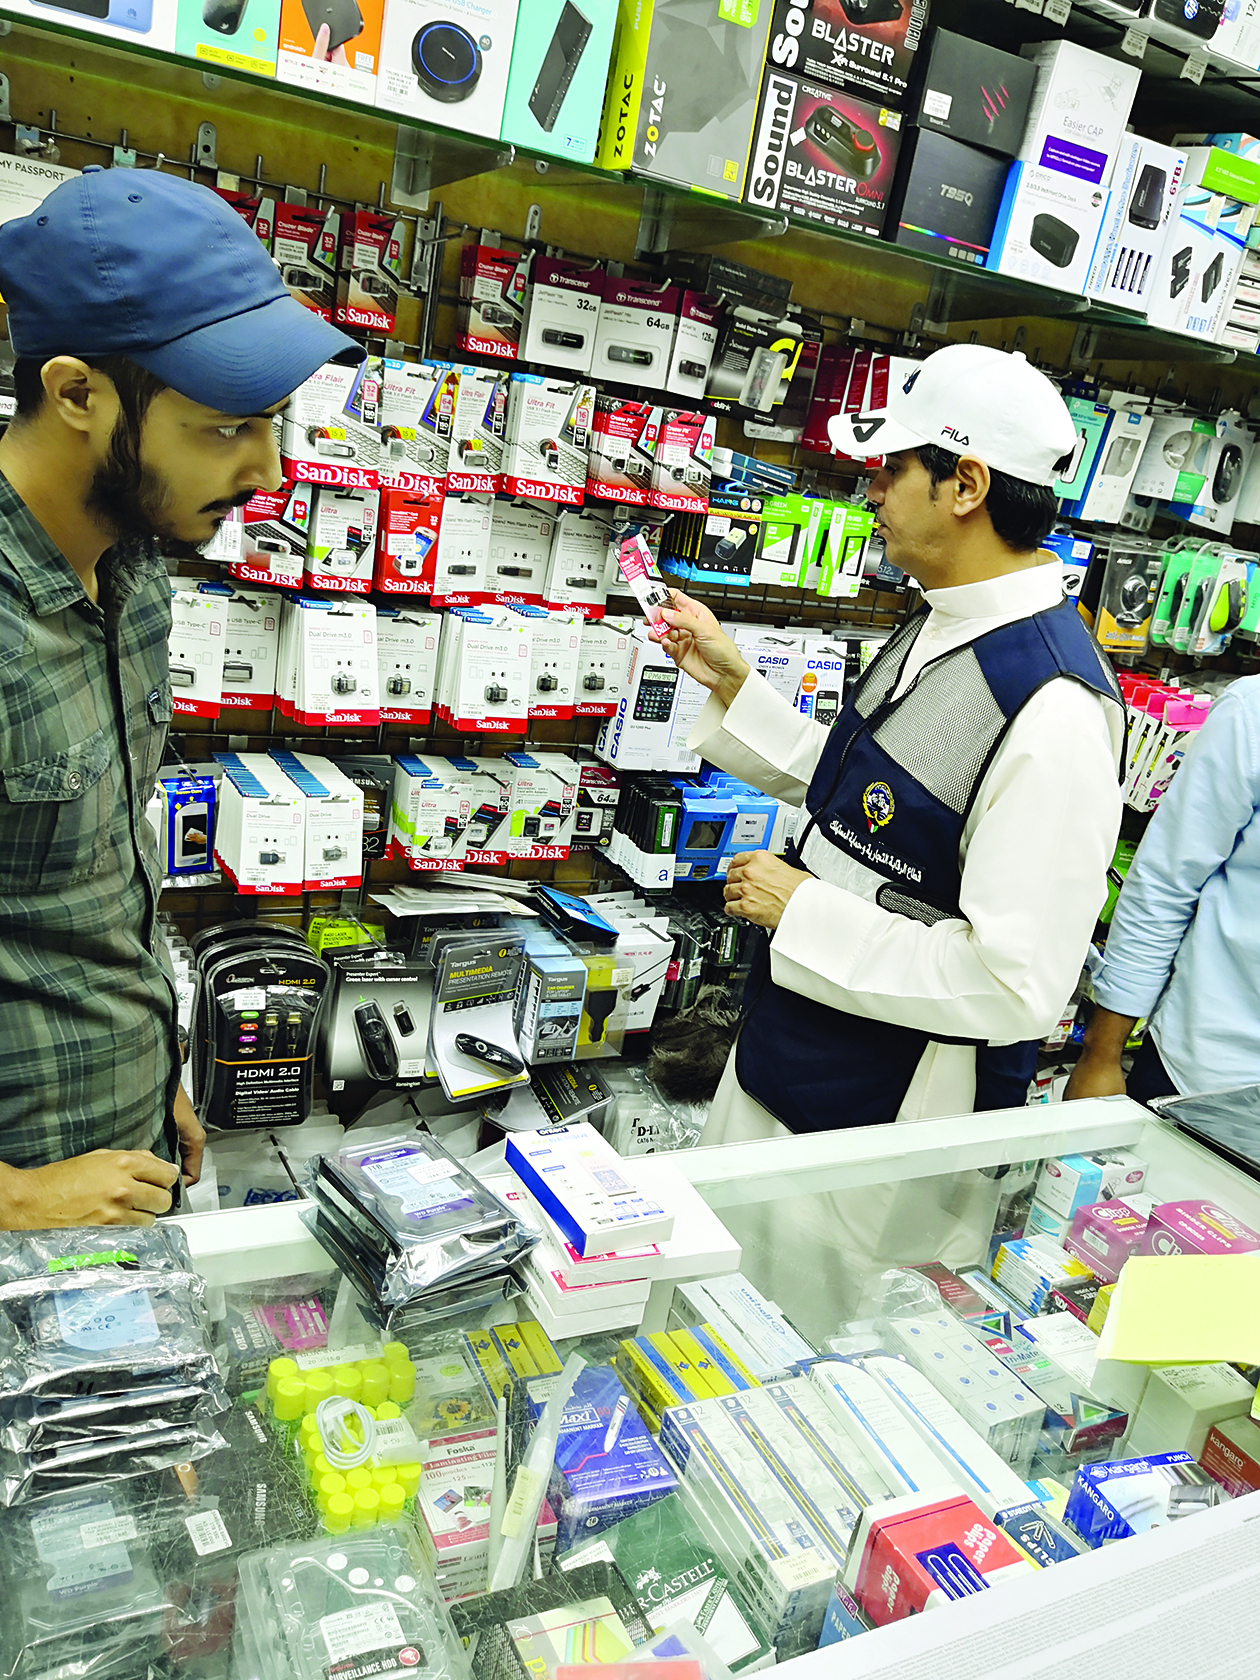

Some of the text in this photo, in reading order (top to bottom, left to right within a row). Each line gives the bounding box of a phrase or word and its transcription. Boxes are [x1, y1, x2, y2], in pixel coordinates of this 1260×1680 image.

[811, 18, 895, 66] BLASTER
[848, 59, 882, 79] Surround
[894, 75, 908, 88] Pro
[801, 85, 834, 102] CREATIVE
[613, 72, 634, 158] ZOTAC
[643, 75, 667, 158] ZOTAC
[1063, 116, 1104, 137] Easier CAP
[754, 80, 794, 202] Sound
[14, 161, 65, 181] PASSPORT
[784, 160, 857, 195] BLASTER
[278, 221, 315, 234] Cruzer Blade
[357, 228, 385, 241] Cruzer Blade
[559, 276, 590, 289] Transcend
[577, 298, 597, 312] 32GB
[626, 295, 662, 307] Transcend
[348, 310, 390, 329] SanDisk
[646, 317, 670, 330] 64GB
[468, 337, 516, 358] SanDisk
[325, 374, 344, 384] Flair
[384, 383, 416, 395] Ultra Fit
[442, 397, 452, 405] 64
[527, 399, 556, 409] Ultra Fit
[578, 411, 587, 419] 16
[941, 425, 970, 446] FILA
[296, 462, 373, 488] SanDisk
[448, 474, 496, 491] SanDisk
[516, 480, 580, 502] SanDisk
[598, 484, 646, 503] SanDisk
[295, 503, 305, 511] 64
[659, 494, 707, 511] SanDisk
[321, 506, 338, 514] Ultra
[240, 566, 298, 587] SanDisk
[313, 576, 368, 592] SanDisk
[384, 579, 433, 593] SanDisk
[444, 594, 470, 604] SanDisk
[495, 594, 526, 604] SanDisk
[563, 605, 591, 615] SanDisk
[758, 656, 789, 666] CASIO
[807, 660, 842, 670] CASIO
[379, 710, 412, 721] SanDisk
[529, 707, 558, 717] SanDisk
[576, 705, 607, 714] SanDisk
[325, 713, 361, 723] SanDisk
[476, 719, 510, 730] SanDisk
[609, 697, 628, 759] CASIO
[413, 859, 461, 870] SanDisk
[254, 884, 285, 893] SanDisk
[320, 879, 347, 888] SanDisk
[450, 960, 477, 968] Targus
[448, 969, 513, 985] PRESENTATION REMOTE
[449, 965, 493, 980] MULTIMEDIA
[237, 1066, 301, 1079] HDMI 2.0
[368, 1163, 383, 1171] 1TB
[425, 1205, 446, 1215] Purple
[1175, 1207, 1233, 1248] BINDER CLIPS
[1003, 1351, 1040, 1364] Tri-Mate
[244, 1410, 268, 1443] SAMSUNG
[446, 1445, 476, 1456] Foska
[430, 1454, 477, 1469] Laminating
[425, 1471, 442, 1480] 100
[1076, 1474, 1115, 1521] KANGARO
[254, 1483, 266, 1527] SAMSUNG
[1020, 1533, 1055, 1566] CLIPS
[328, 1658, 398, 1680] SURVEILLANCE HDD
